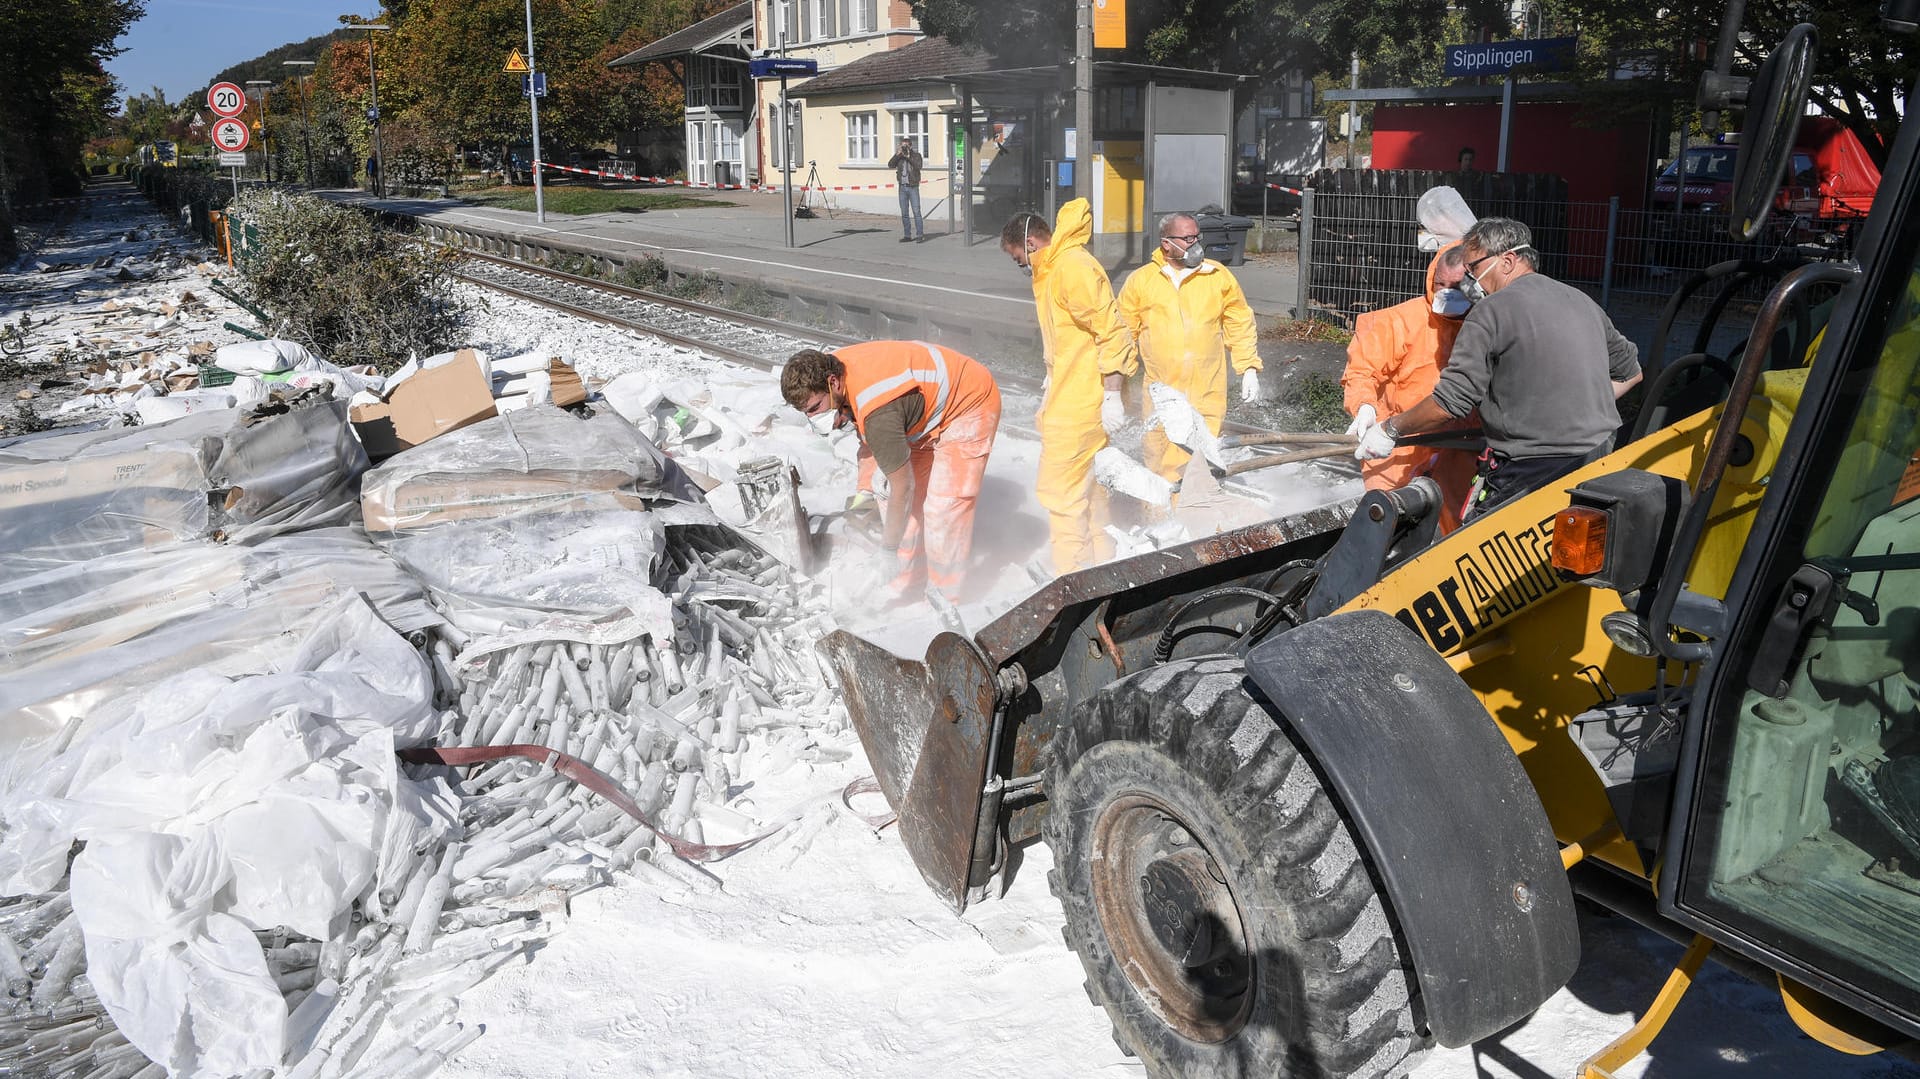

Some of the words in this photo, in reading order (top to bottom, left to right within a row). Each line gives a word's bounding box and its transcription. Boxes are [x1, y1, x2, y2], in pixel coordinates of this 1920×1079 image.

[1453, 48, 1533, 70] Sipplingen
[217, 93, 237, 107] 20
[1394, 514, 1558, 654] erAllra
